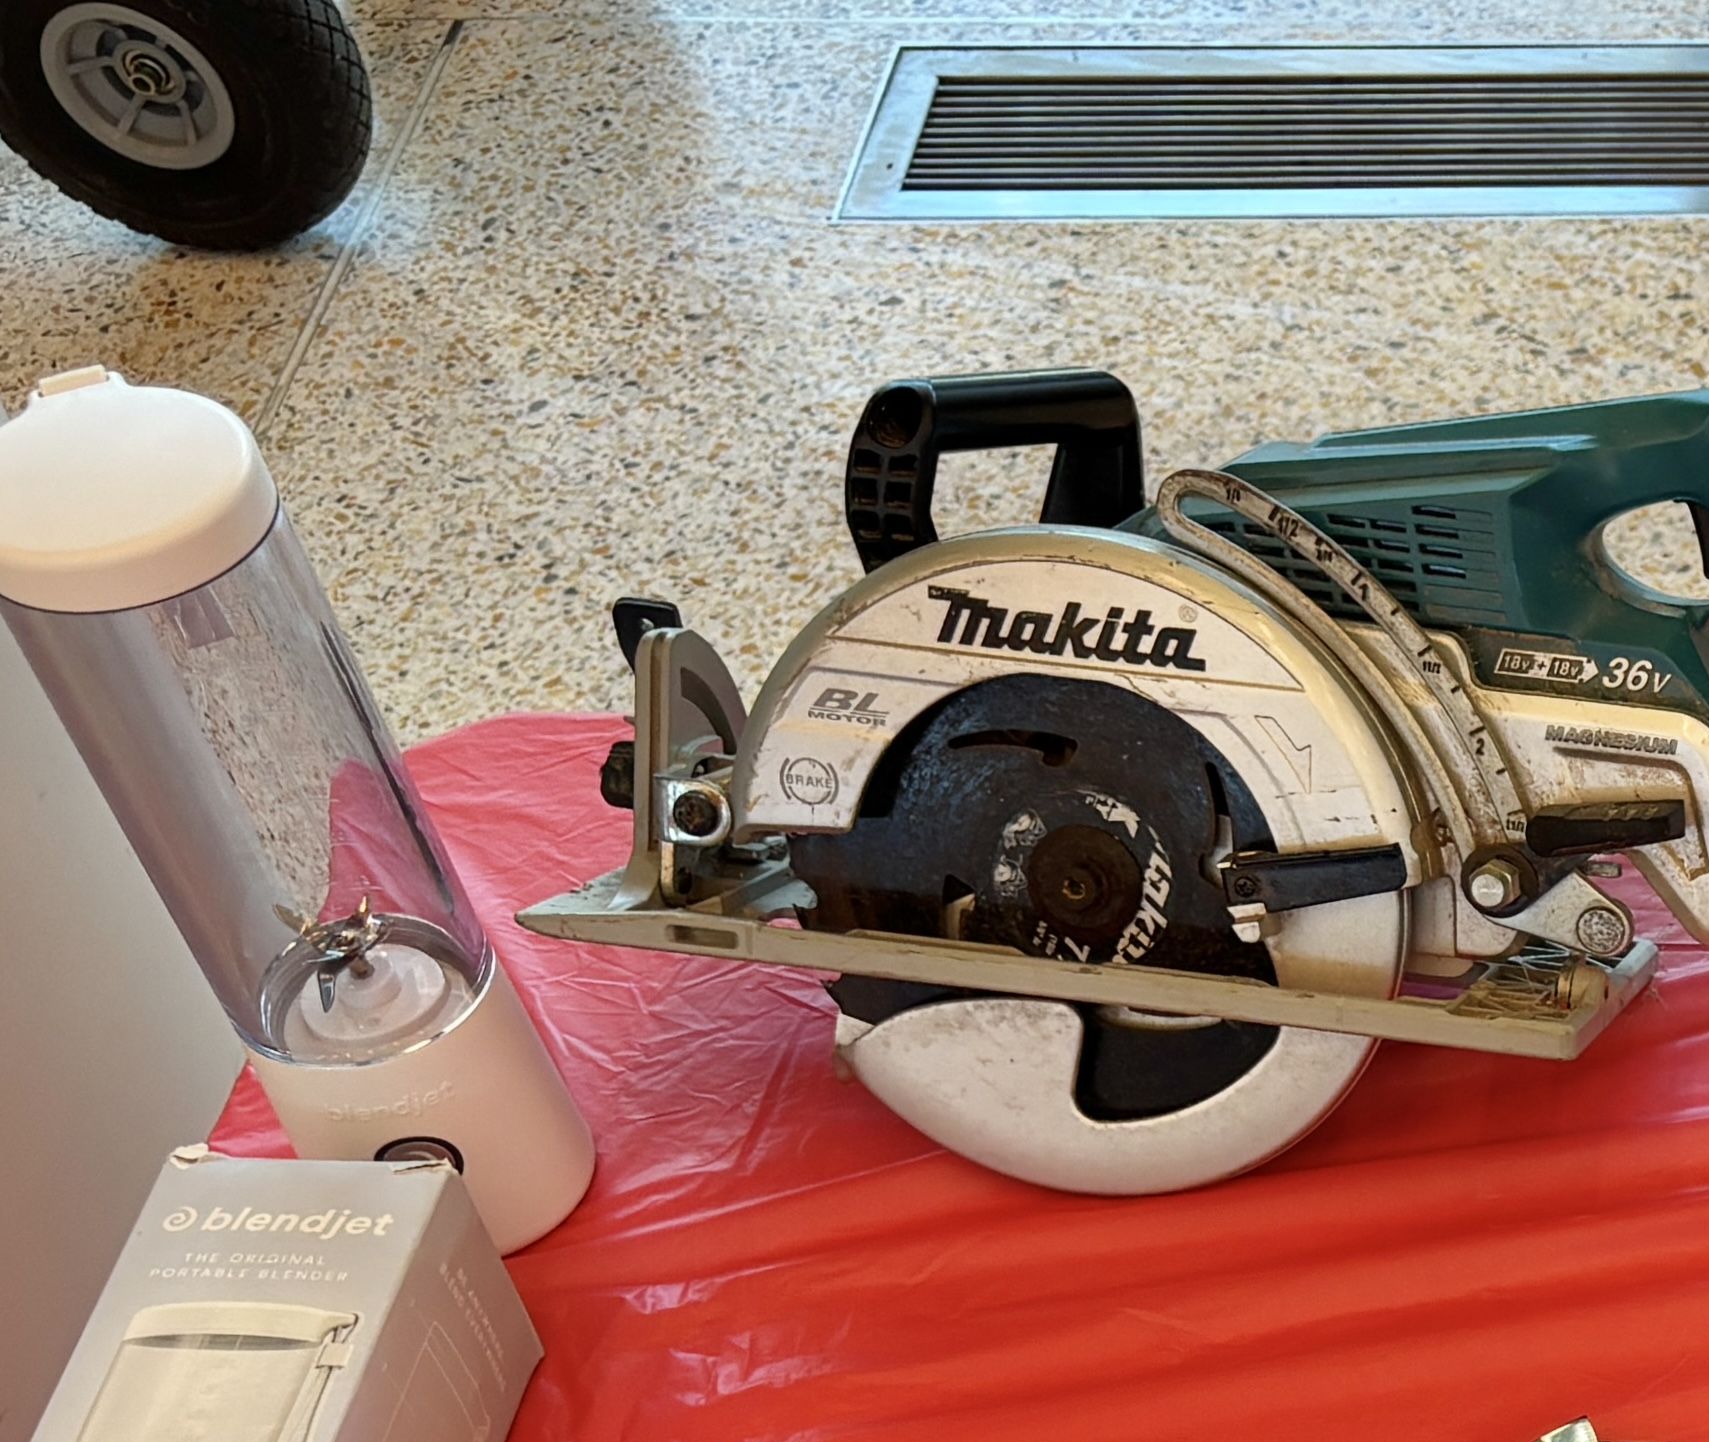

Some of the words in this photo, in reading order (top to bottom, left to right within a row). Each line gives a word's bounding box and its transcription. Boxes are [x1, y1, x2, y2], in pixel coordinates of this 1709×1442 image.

[813, 687, 890, 715] BL
[807, 710, 887, 727] MOTOR
[1545, 725, 1678, 755] MAGNESIUM
[785, 773, 833, 789] BRAKE
[325, 1080, 455, 1121] blendjet
[201, 1207, 394, 1240] blendjet
[149, 1267, 250, 1280] PORTABLE
[258, 1268, 348, 1282] BLENDER
